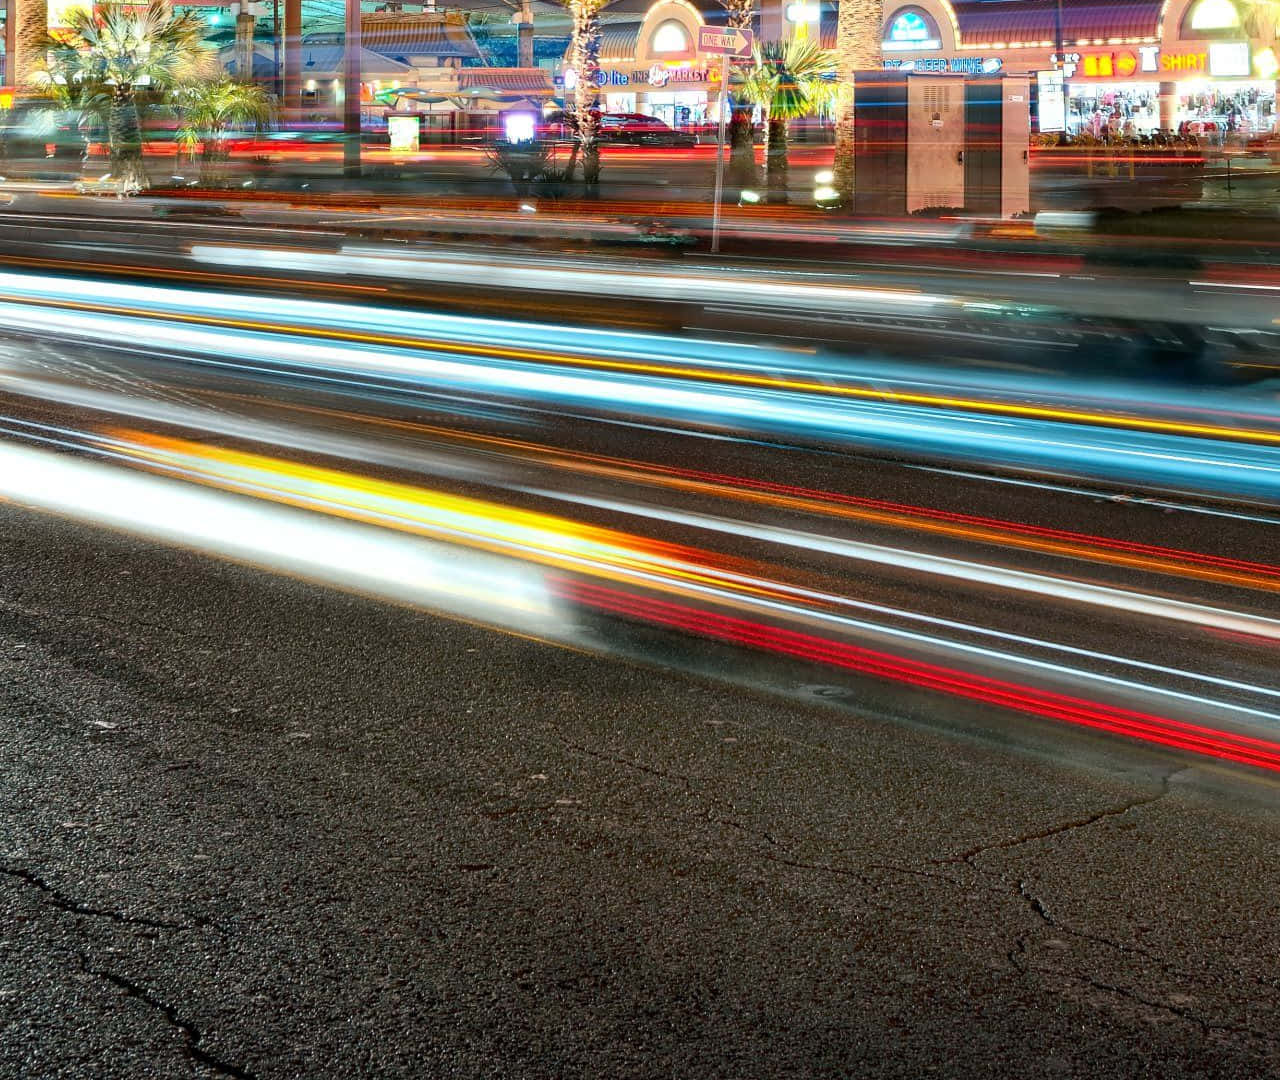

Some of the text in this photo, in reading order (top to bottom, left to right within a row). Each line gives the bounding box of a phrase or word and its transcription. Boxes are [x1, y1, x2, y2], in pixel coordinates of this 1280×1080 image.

[702, 33, 736, 48] ONE WAY
[1161, 53, 1207, 70] SHIRT
